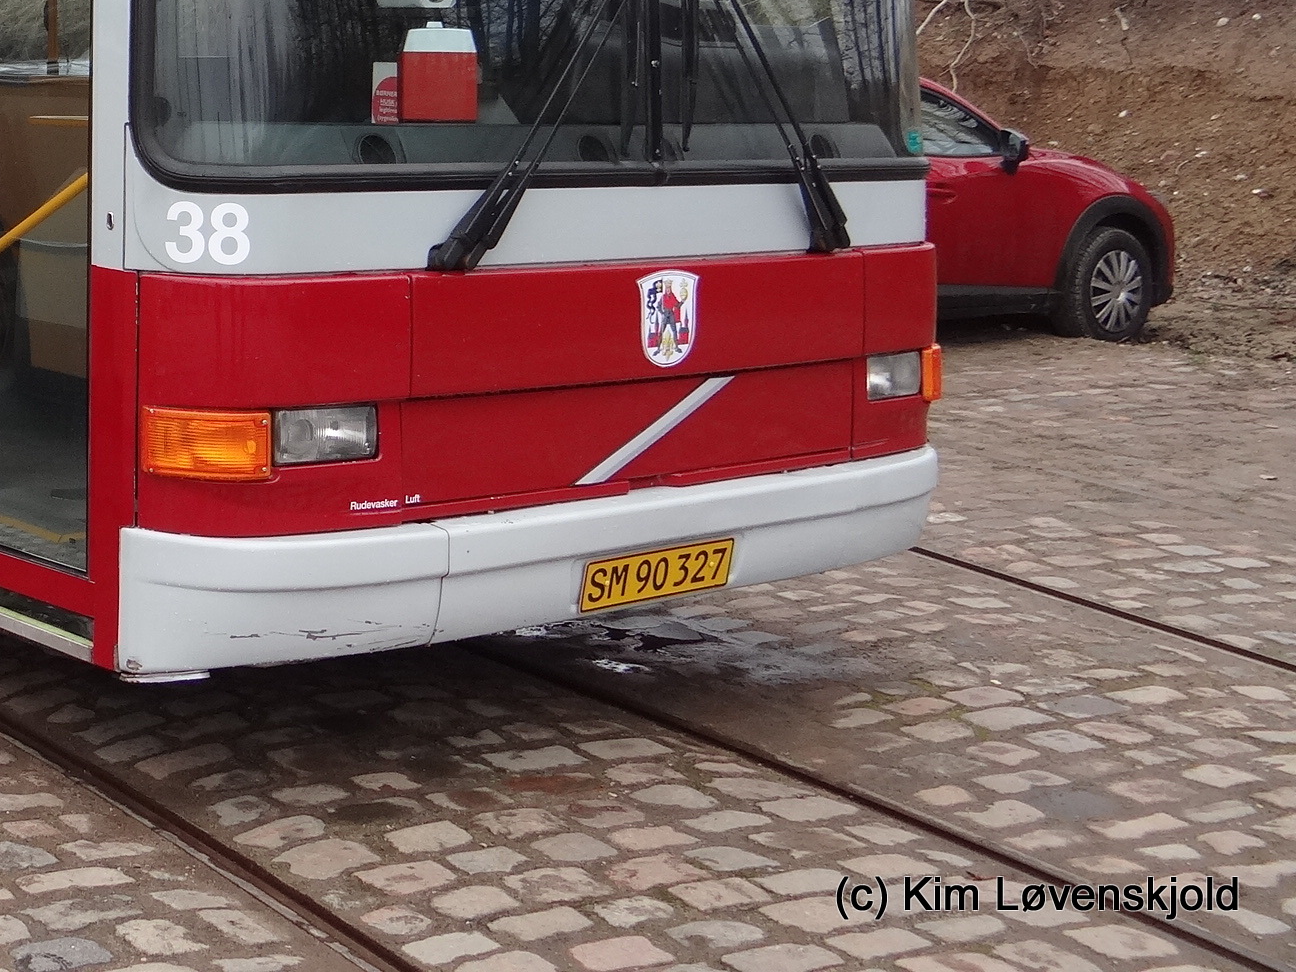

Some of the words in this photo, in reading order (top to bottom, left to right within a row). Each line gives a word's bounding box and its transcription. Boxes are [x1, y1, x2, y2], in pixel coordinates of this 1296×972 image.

[165, 201, 250, 265] 38
[350, 499, 398, 510] Rudevasker
[405, 494, 420, 504] Luft
[588, 564, 629, 603] SM
[636, 557, 669, 594] 90
[673, 548, 727, 587] 327
